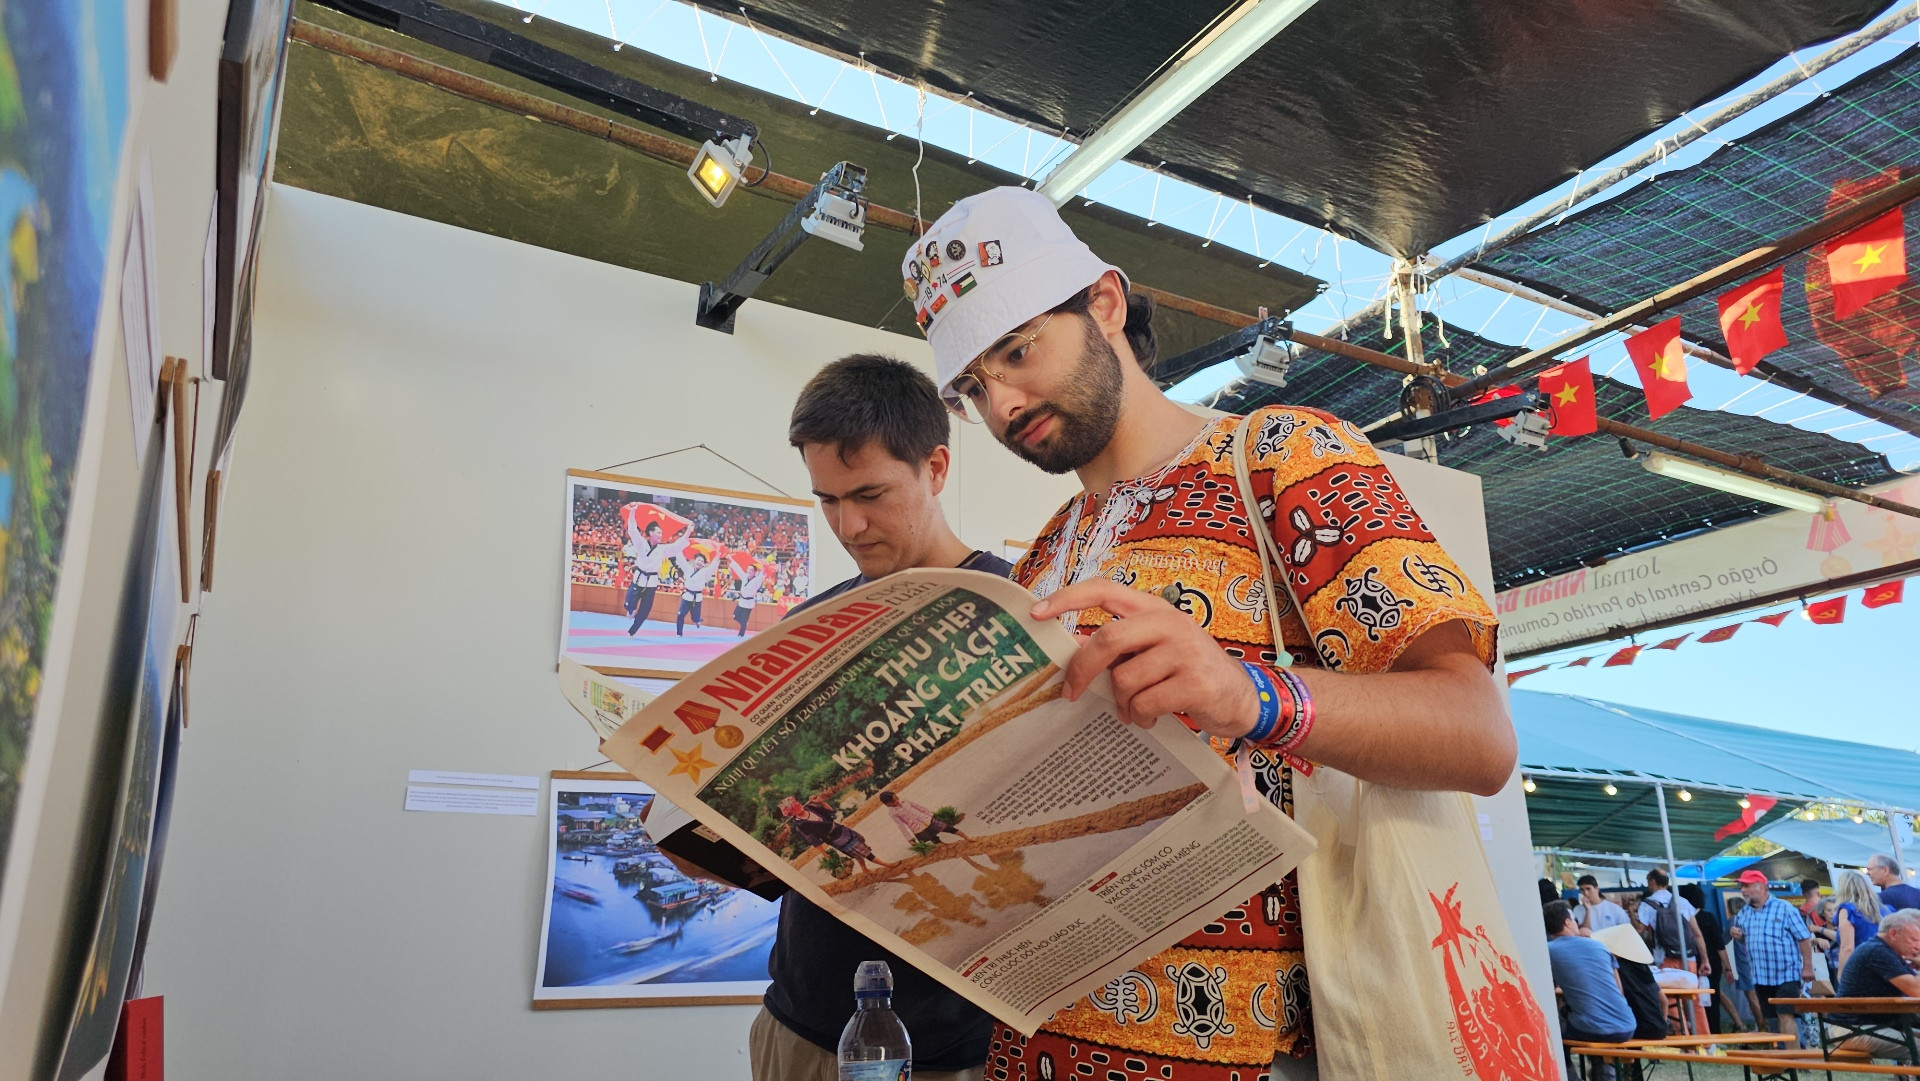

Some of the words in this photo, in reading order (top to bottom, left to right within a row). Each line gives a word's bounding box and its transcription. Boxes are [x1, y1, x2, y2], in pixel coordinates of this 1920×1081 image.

[936, 273, 948, 288] 74
[700, 637, 813, 711] Nhân
[787, 600, 884, 645] Dân
[873, 636, 933, 686] THU
[927, 603, 978, 643] HẸP
[758, 699, 776, 716] QUAN
[774, 683, 795, 701] TRUNG
[832, 670, 939, 772] KHOẢNG
[938, 616, 1009, 682] CÁCH
[894, 704, 960, 762] PHÁT
[955, 642, 1034, 708] TRIỂN
[1104, 882, 1138, 905] VACCINE
[1136, 871, 1151, 884] TAY
